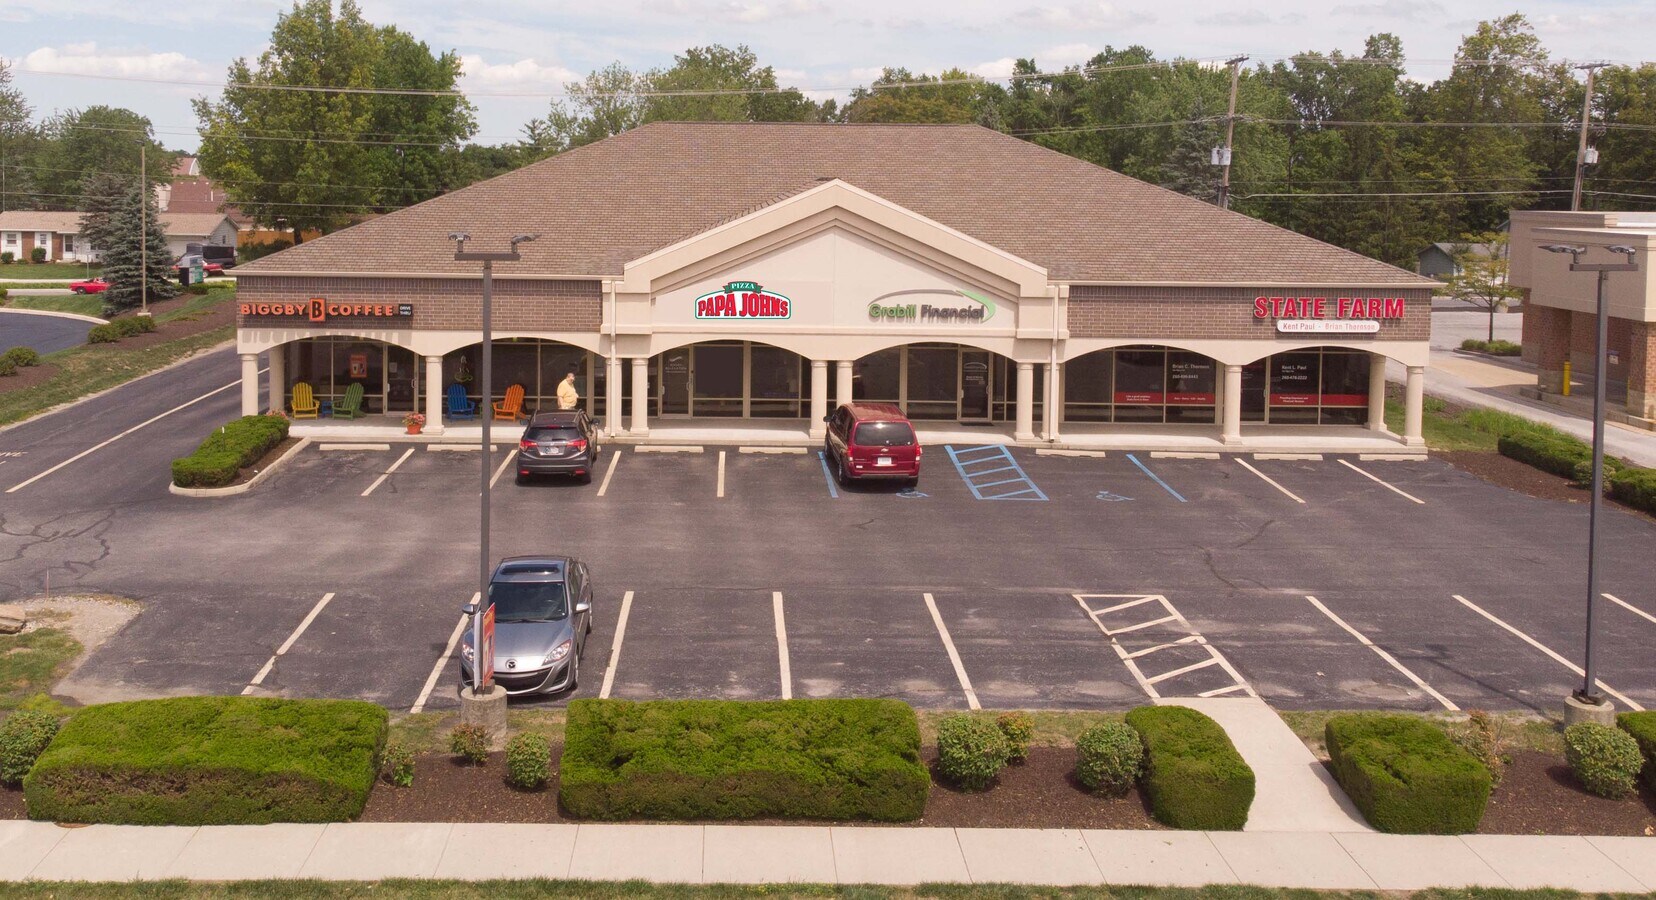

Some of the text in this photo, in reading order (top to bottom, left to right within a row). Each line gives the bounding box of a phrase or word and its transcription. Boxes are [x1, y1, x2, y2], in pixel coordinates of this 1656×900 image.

[240, 300, 394, 319] BIGGBY B COFFEE
[698, 293, 737, 317] PAPA
[868, 303, 985, 319] Grabill Financial
[1254, 297, 1405, 319] STATE FARM
